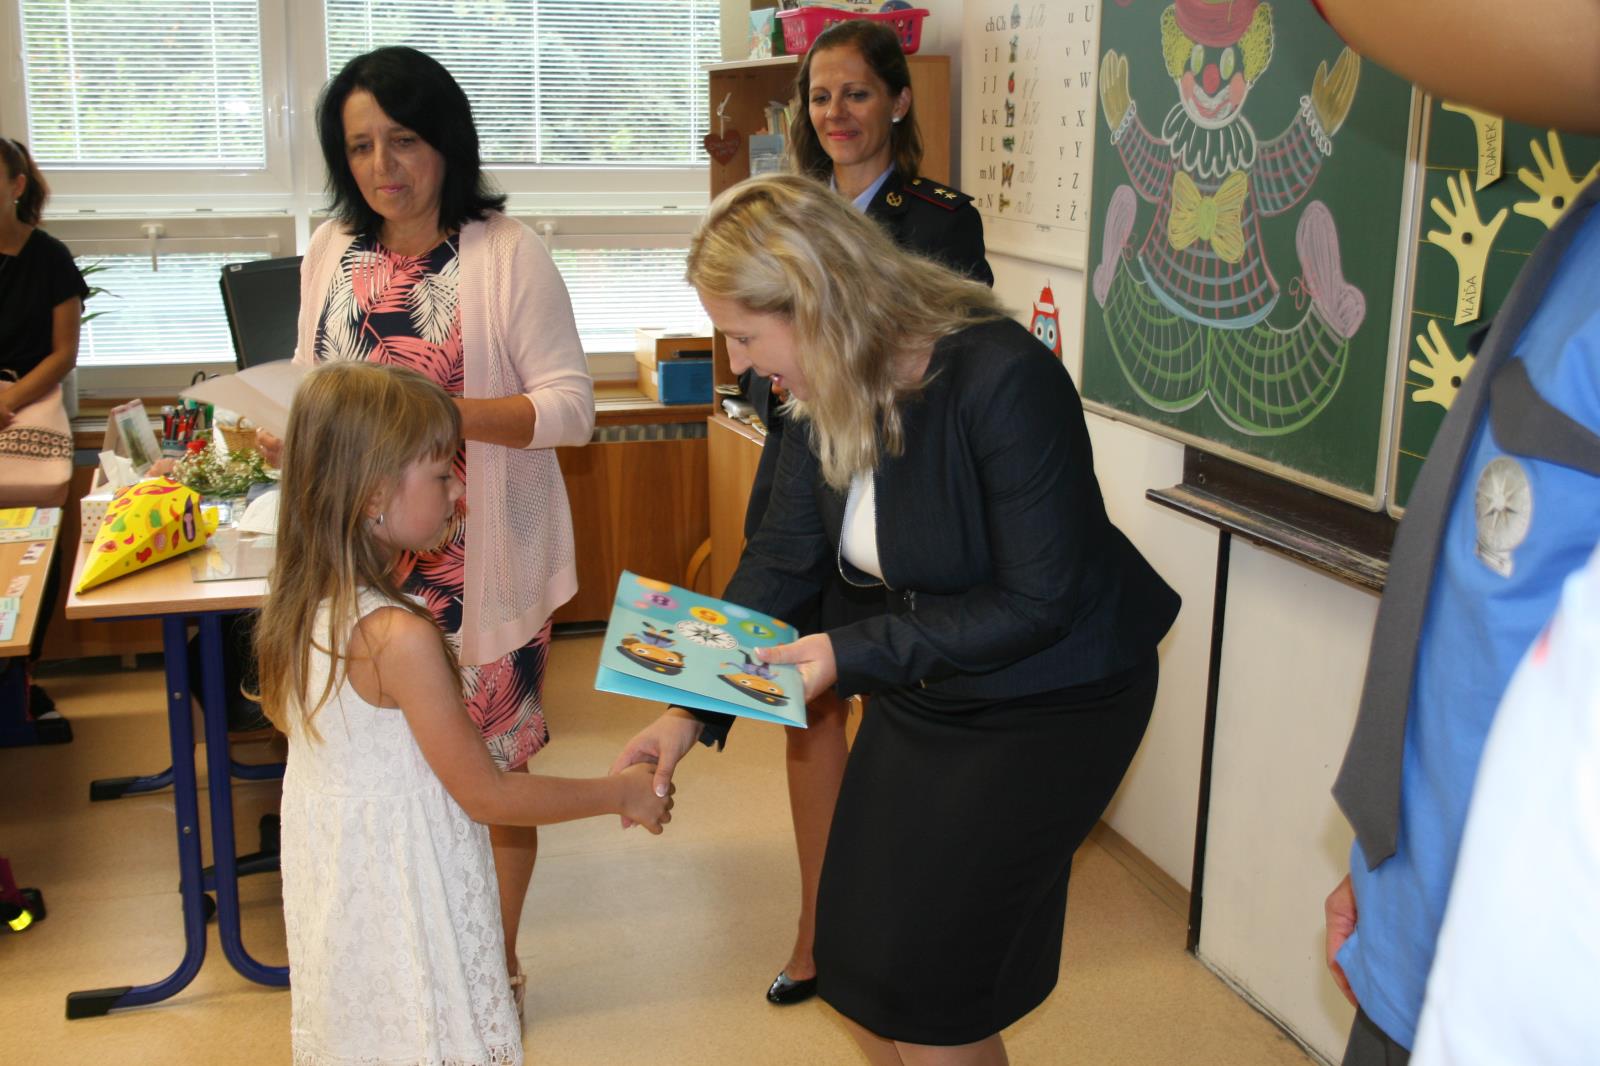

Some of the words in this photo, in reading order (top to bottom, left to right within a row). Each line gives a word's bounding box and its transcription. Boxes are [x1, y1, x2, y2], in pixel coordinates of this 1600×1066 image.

[996, 16, 1006, 31] Ch
[1082, 39, 1090, 56] V
[1080, 71, 1091, 88] W
[1076, 110, 1085, 127] X
[1075, 141, 1082, 157] Y
[988, 165, 996, 180] M
